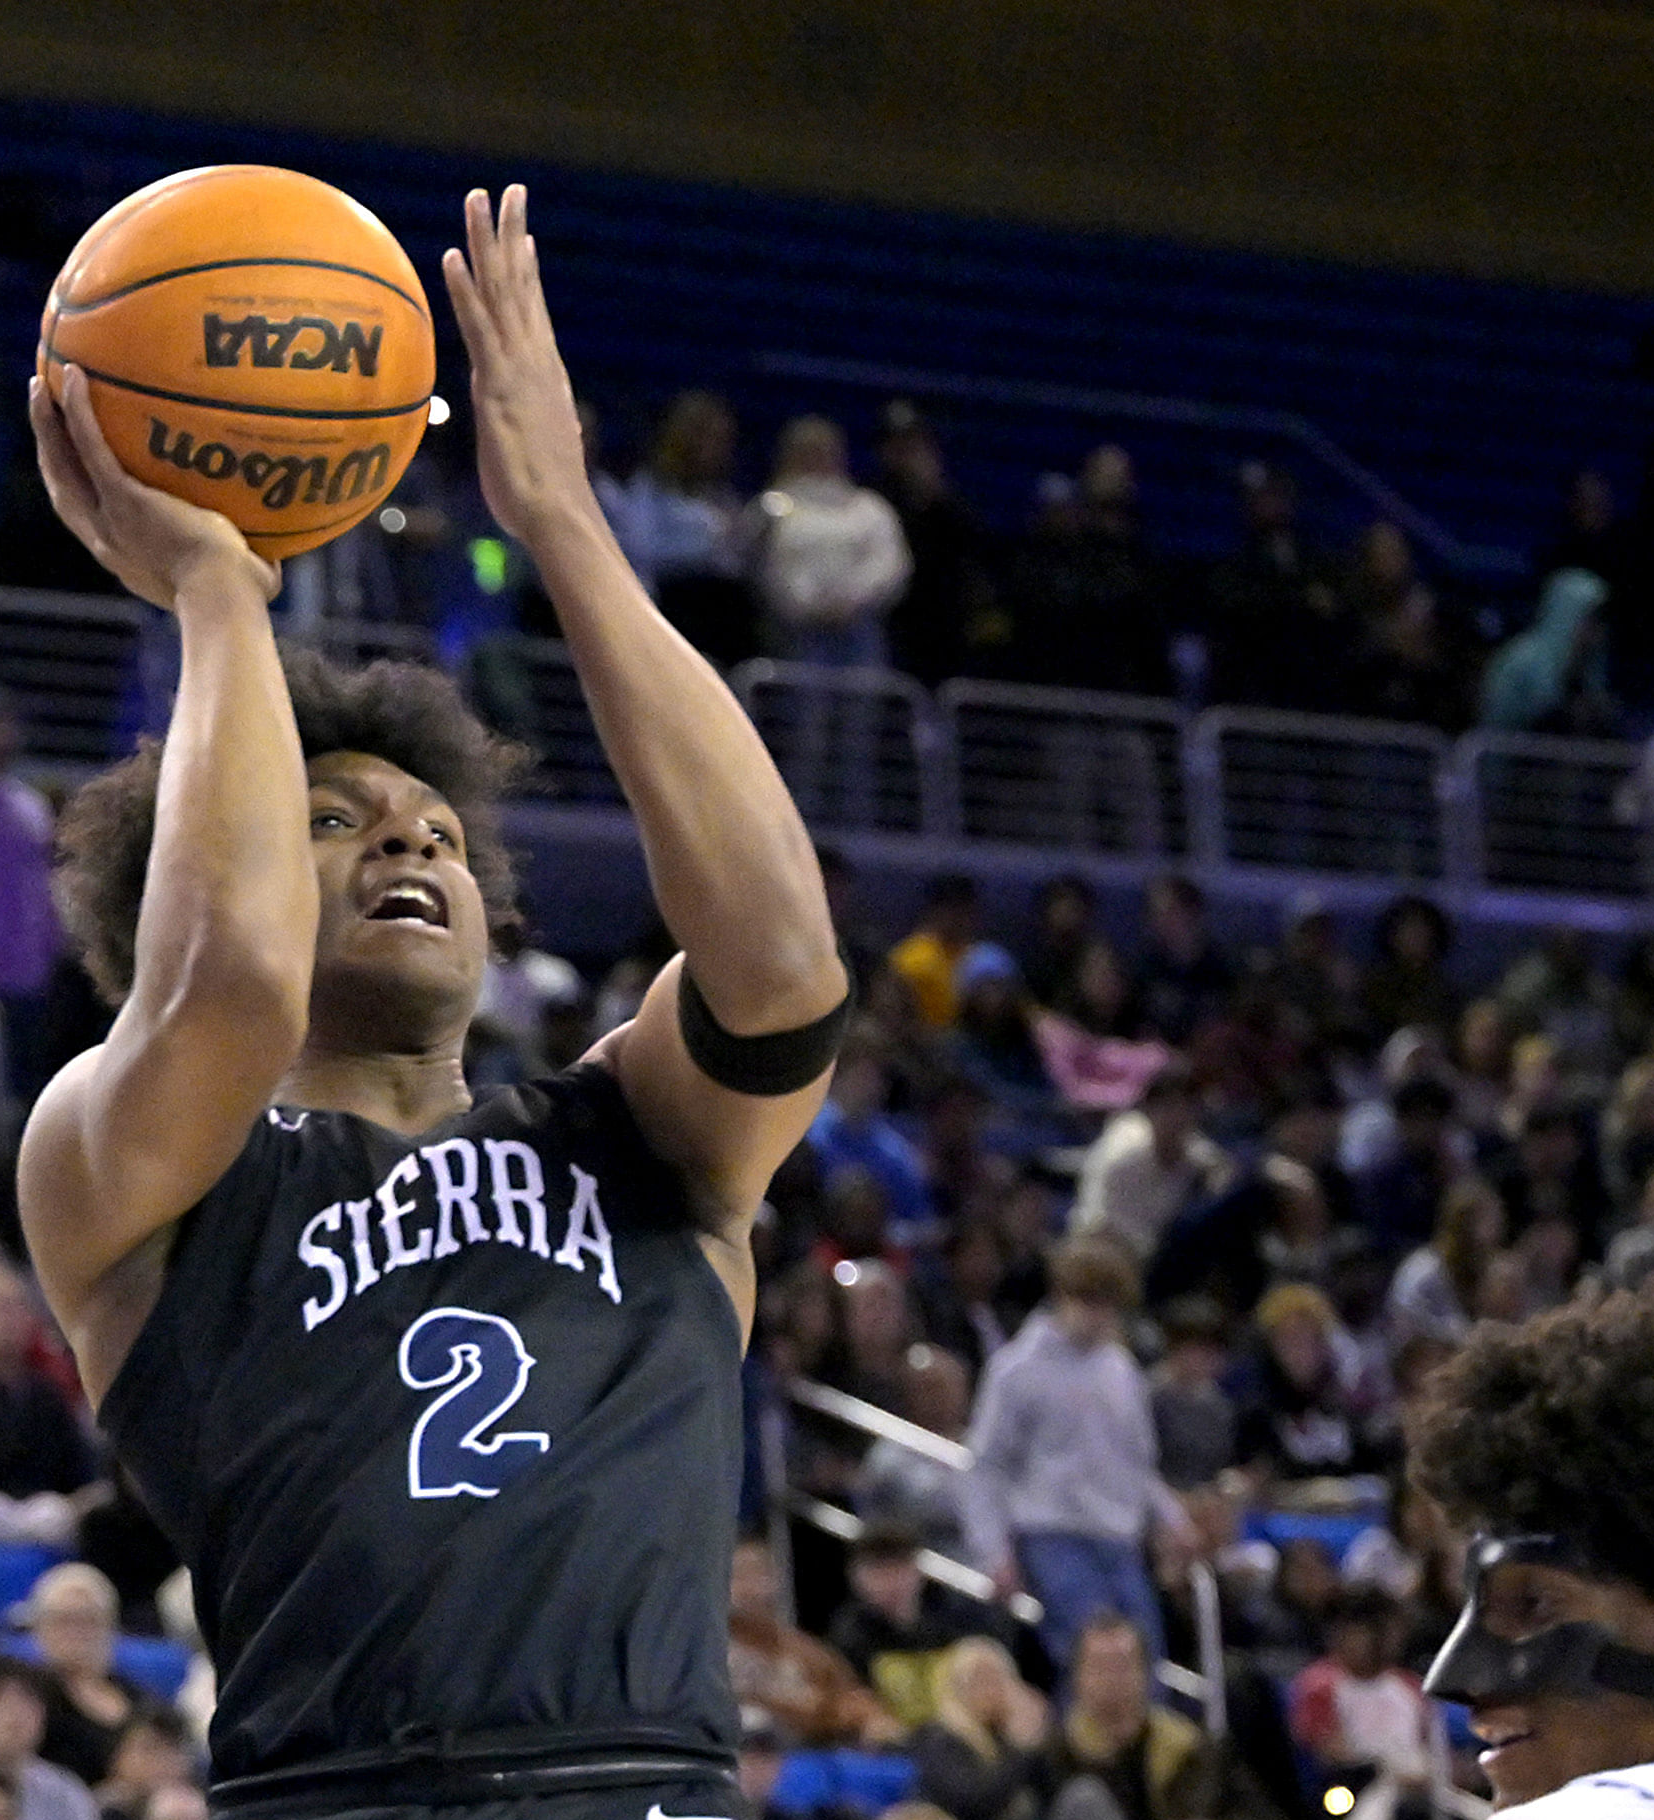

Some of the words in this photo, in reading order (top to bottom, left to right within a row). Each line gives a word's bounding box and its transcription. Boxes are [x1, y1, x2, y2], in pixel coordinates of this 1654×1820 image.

[204, 312, 383, 377] NCAA
[148, 416, 389, 509] Wilson
[298, 1138, 623, 1331] SIERRA
[399, 1307, 550, 1500] 2
